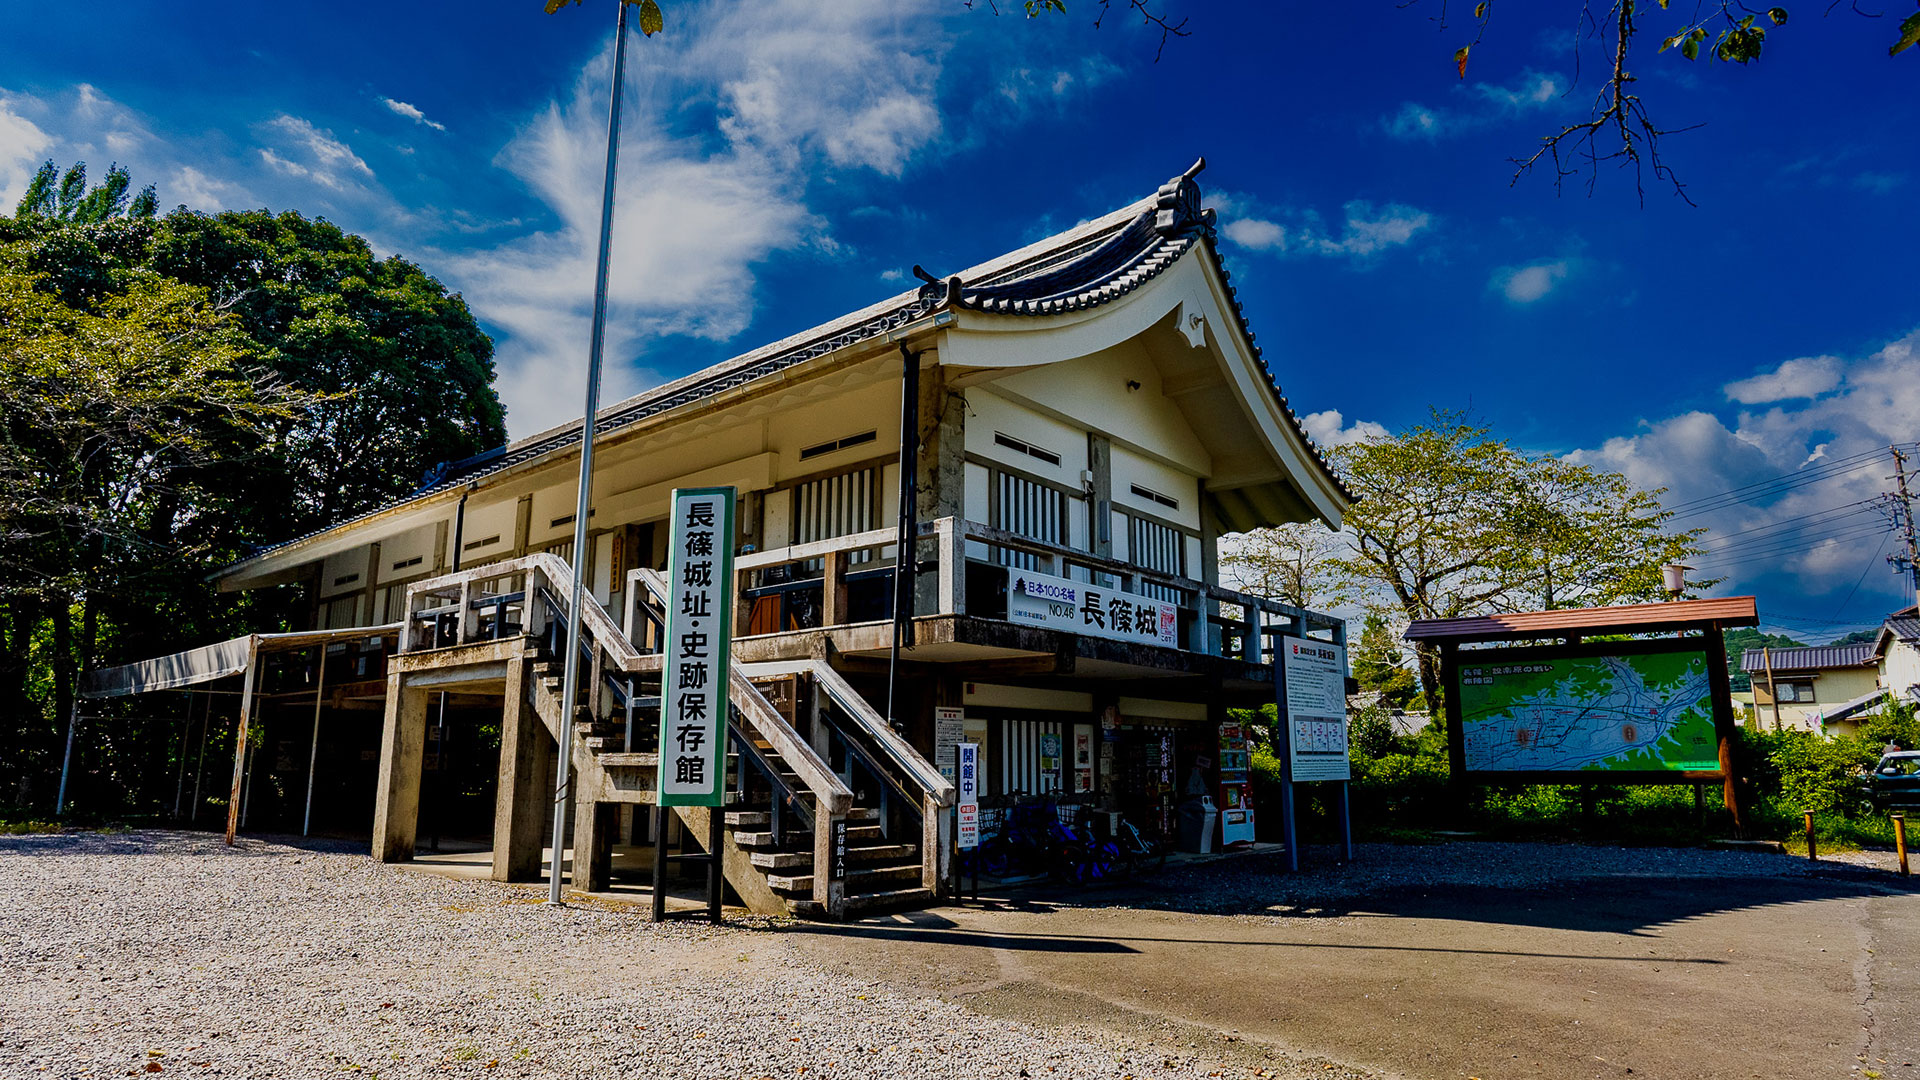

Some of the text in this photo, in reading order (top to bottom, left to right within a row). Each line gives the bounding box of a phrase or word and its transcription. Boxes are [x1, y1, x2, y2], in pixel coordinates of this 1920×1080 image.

[1028, 581, 1076, 602] 日本100名城
[1048, 603, 1074, 620] NO.46
[1080, 591, 1158, 637] 長篠城
[675, 501, 715, 786] 長篠城址・史跡保存館
[962, 748, 974, 796] 開館中
[836, 823, 846, 878] 保存館入口
